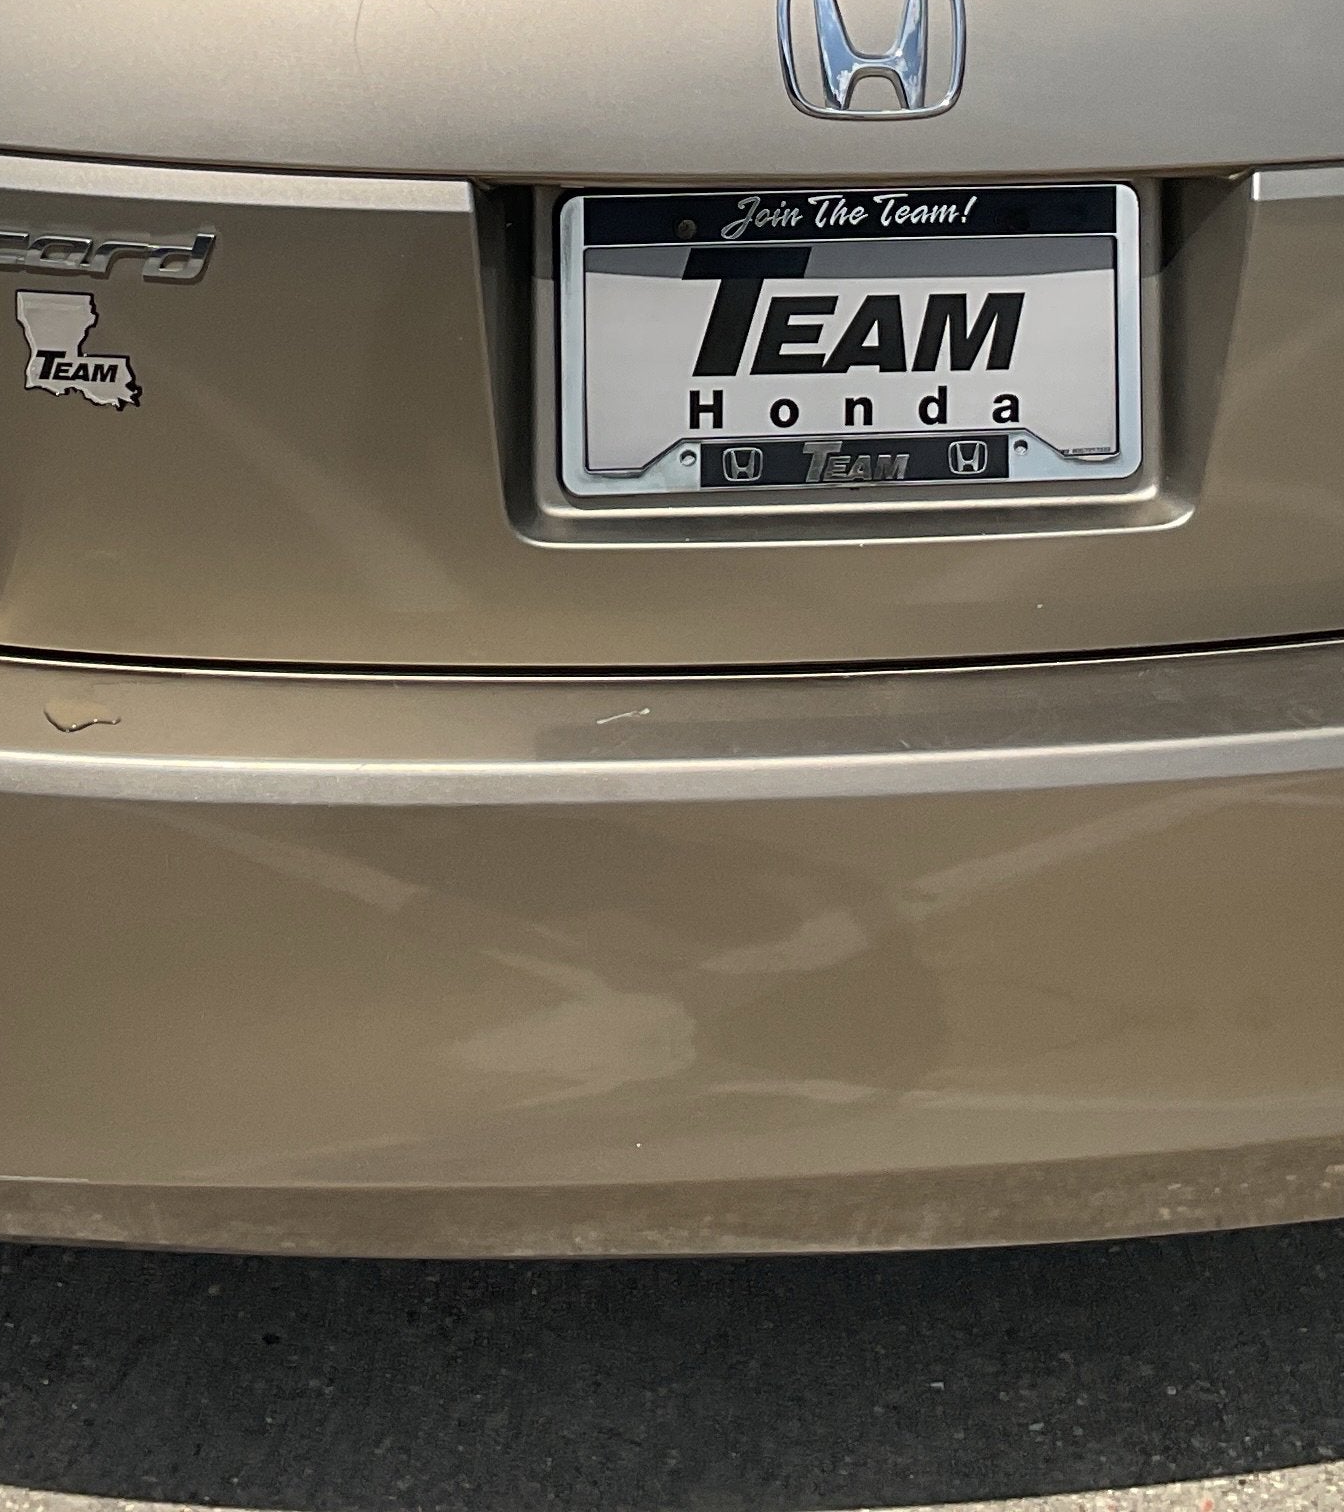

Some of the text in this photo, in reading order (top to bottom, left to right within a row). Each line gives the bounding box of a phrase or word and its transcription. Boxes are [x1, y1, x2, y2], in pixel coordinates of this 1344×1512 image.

[721, 193, 978, 240] Join The Team!
[681, 246, 1027, 377] TEAM
[35, 349, 119, 383] TEAM
[689, 385, 1021, 430] Honda
[803, 440, 910, 483] TEAM
